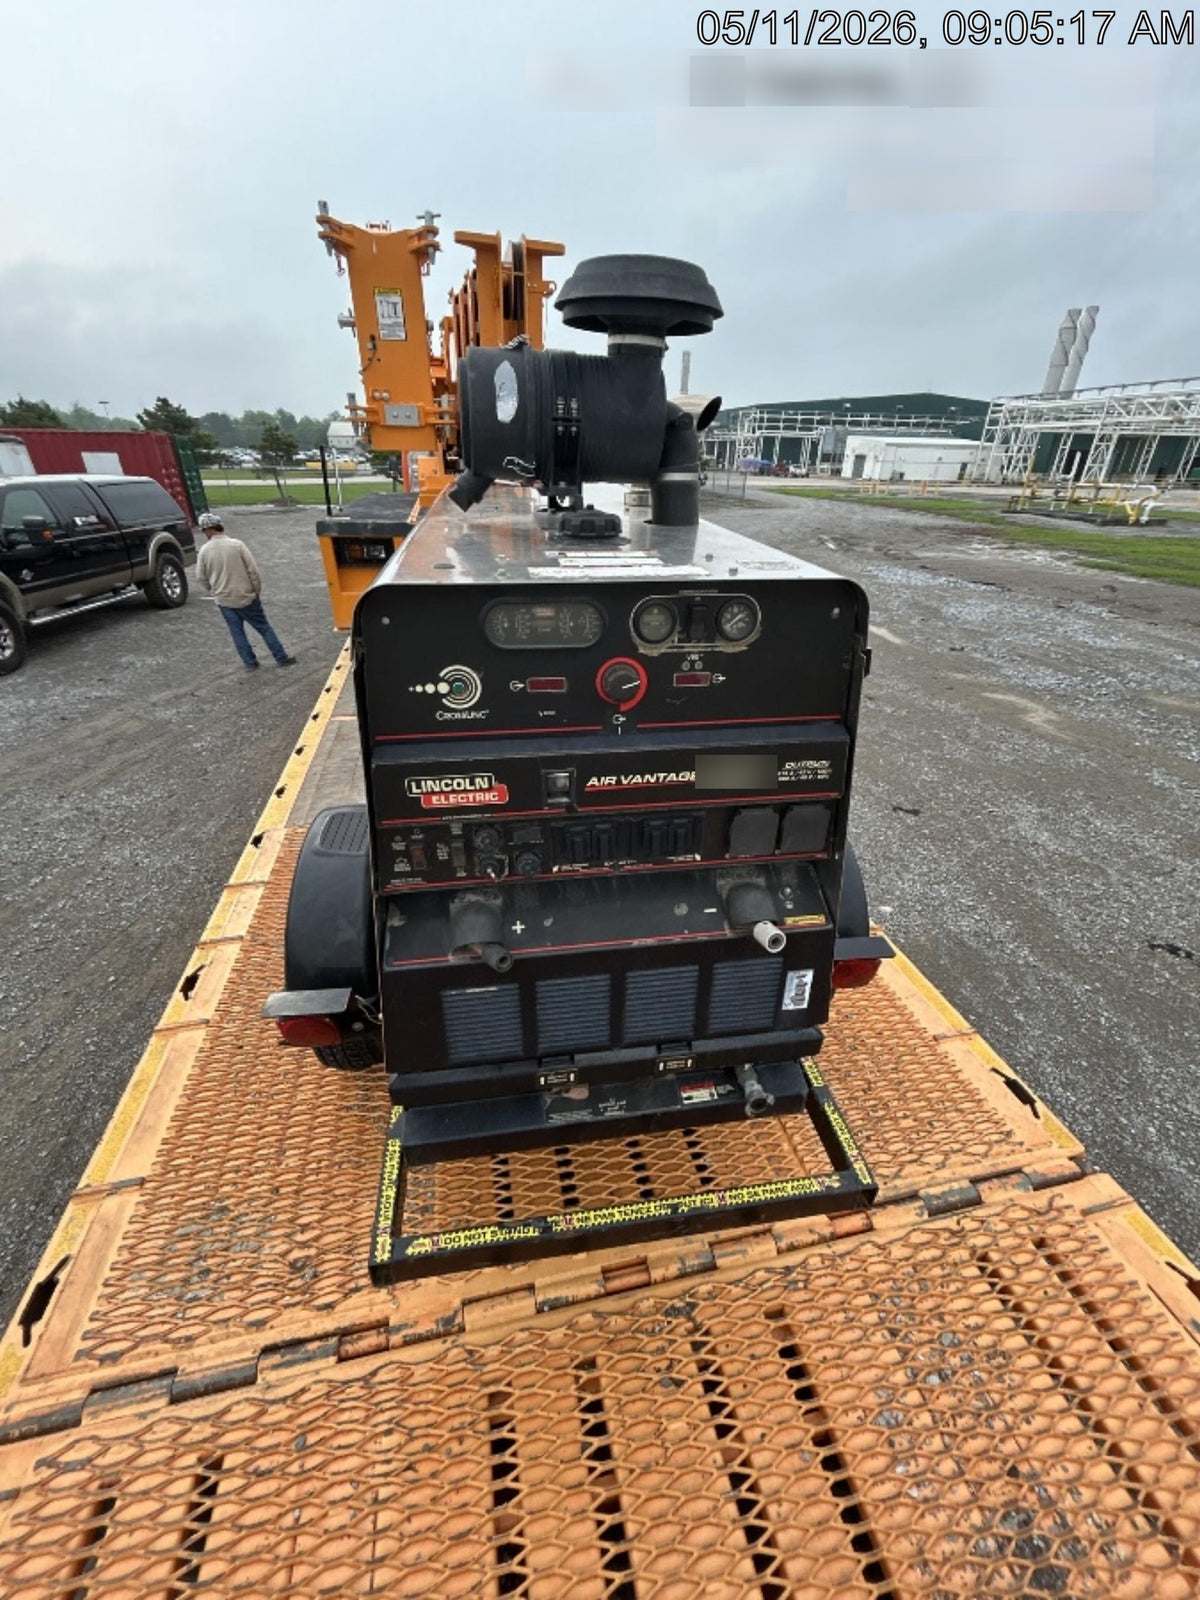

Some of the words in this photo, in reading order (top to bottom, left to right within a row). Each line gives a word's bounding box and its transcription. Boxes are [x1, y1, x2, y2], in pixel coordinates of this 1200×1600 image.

[411, 777, 489, 793] LINCOLN
[586, 776, 618, 787] AIR
[432, 792, 499, 805] ELECTRIC
[444, 1235, 461, 1246] DO
[464, 1231, 488, 1242] NOT
